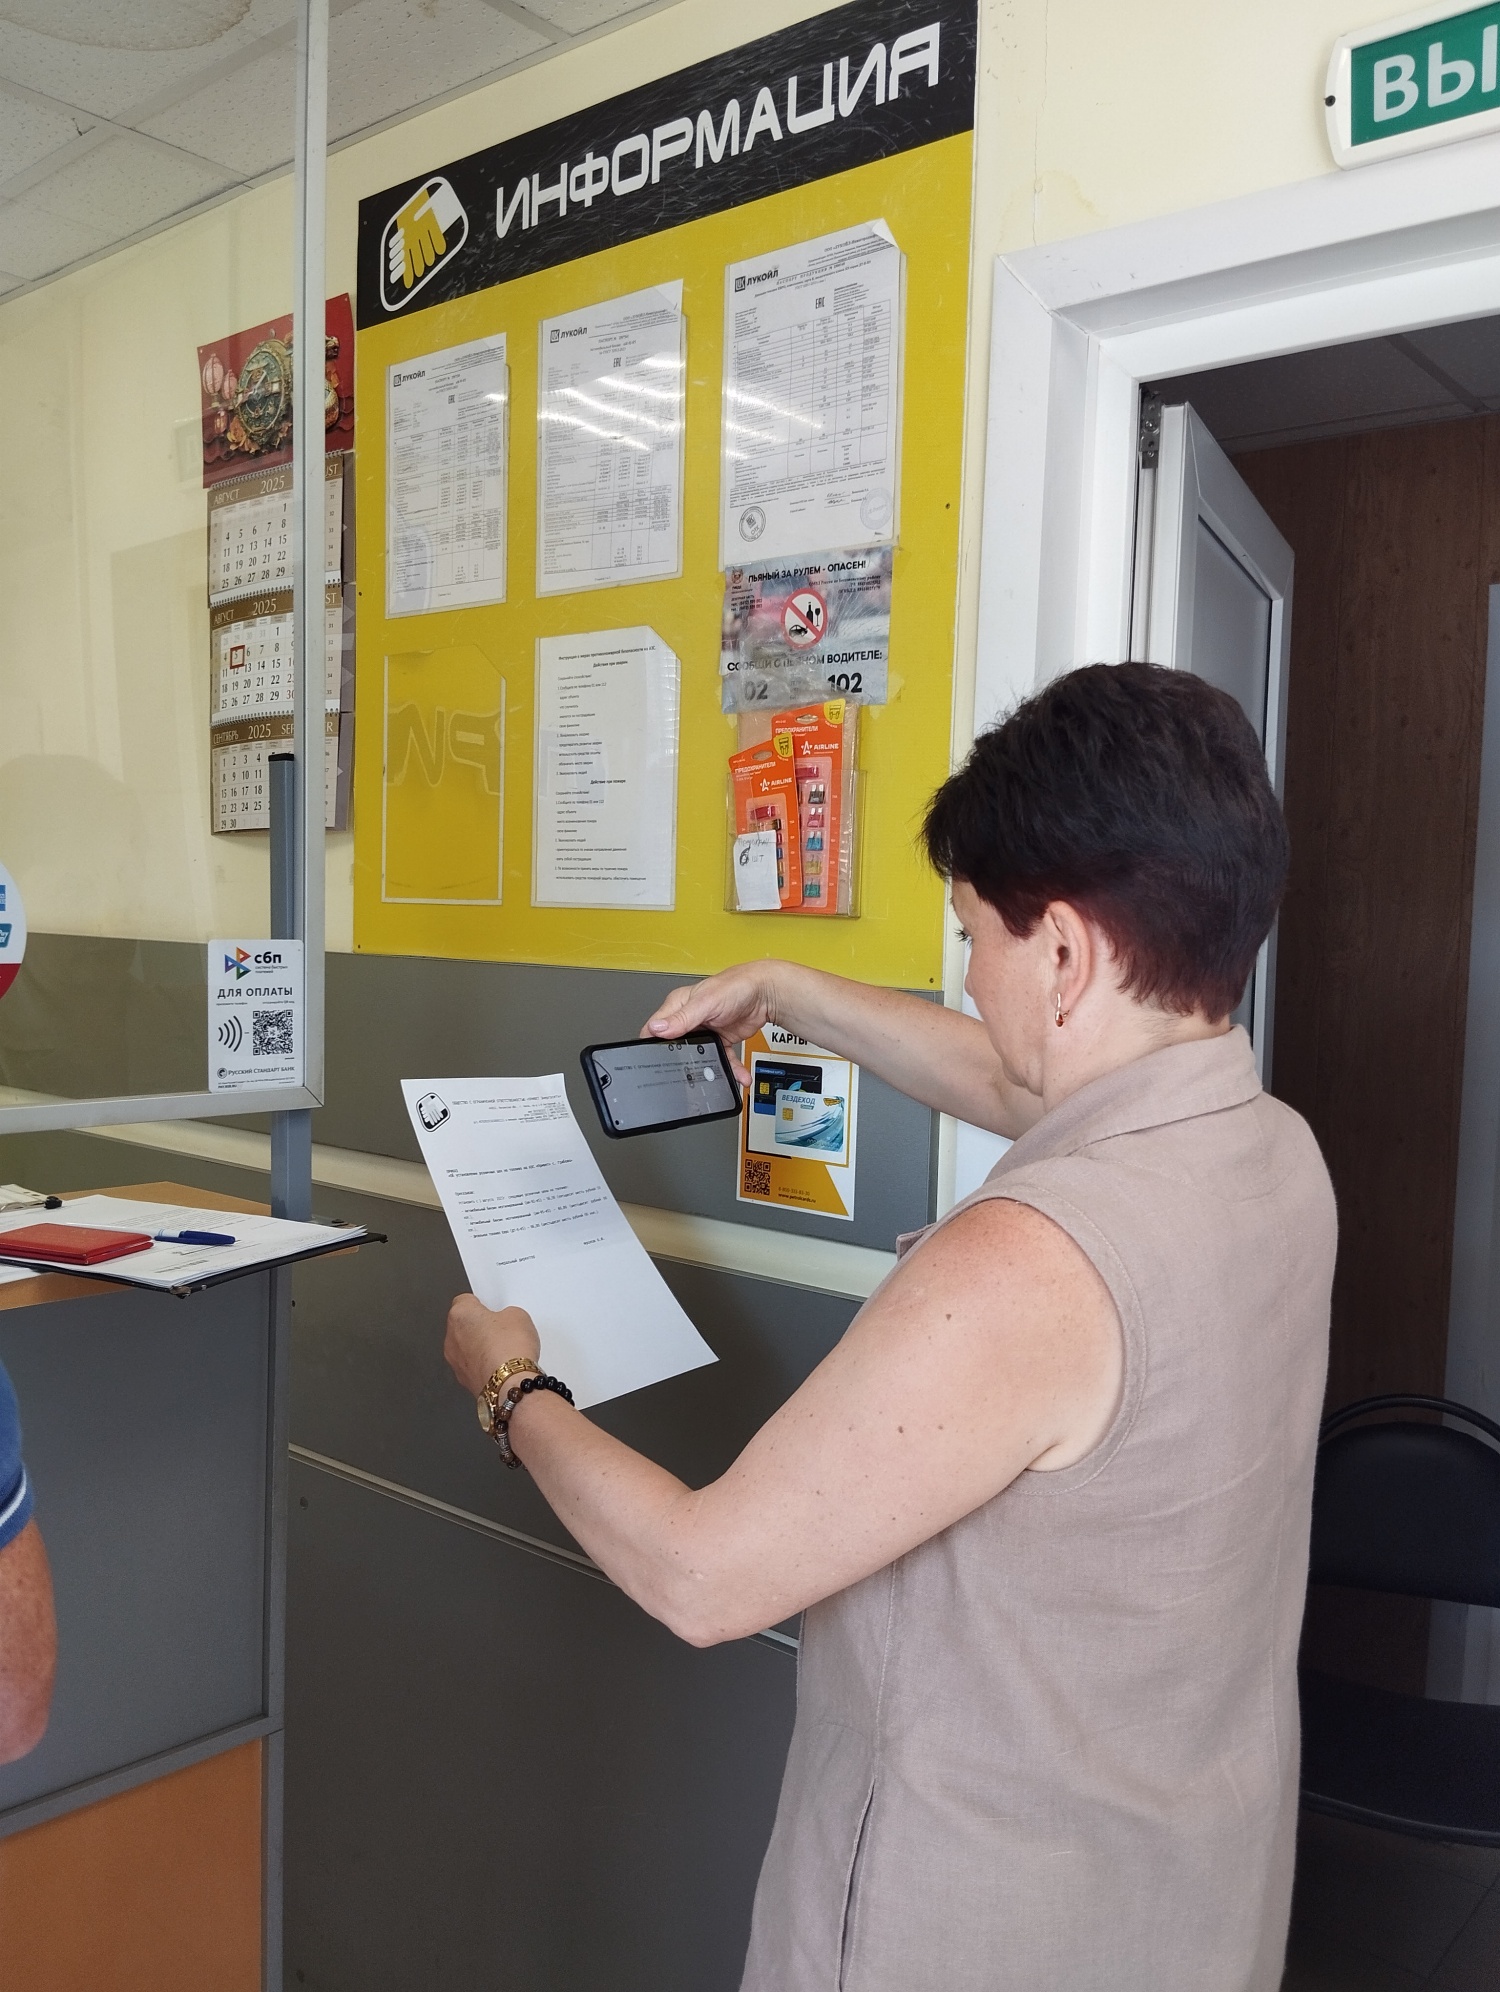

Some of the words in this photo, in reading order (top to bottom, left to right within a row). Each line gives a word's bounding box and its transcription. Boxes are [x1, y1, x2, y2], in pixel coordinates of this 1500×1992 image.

[1374, 24, 1498, 122] ВЫ
[496, 22, 941, 238] ИНФОРМАЦИЯ
[747, 270, 778, 286] ЛУКОЙЛ
[561, 327, 587, 338] ЛУКОЙЛ
[402, 370, 425, 382] ЛУКОЙЛ
[213, 488, 240, 505] АВГУСТ
[260, 475, 285, 494] 2025
[283, 503, 287, 512] 1
[226, 532, 230, 541] 4
[239, 529, 243, 538] 5
[252, 525, 257, 535] 6
[267, 522, 271, 532] 7
[281, 519, 286, 529] 8
[224, 548, 230, 557] 11
[236, 544, 244, 554] 12
[250, 541, 258, 551] 13
[264, 538, 272, 548] 14
[279, 534, 287, 544] 15
[223, 563, 230, 573] 18
[236, 560, 243, 570] 19
[249, 557, 256, 567] 20
[263, 554, 270, 564] 21
[277, 551, 286, 561] 22
[222, 579, 229, 589] 25
[234, 576, 242, 585] 26
[248, 573, 256, 583] 27
[261, 570, 269, 580] 28
[276, 567, 285, 577] 29
[748, 569, 780, 583] ПЬЯНЫЙ
[781, 568, 792, 578] ЗА
[794, 565, 821, 577] РУЛЕМ
[828, 560, 867, 573] ОПАСЕН!
[214, 609, 234, 623] АВГУСТ
[253, 599, 277, 616] 2025
[276, 627, 279, 636] 1
[224, 652, 227, 661] 4
[234, 650, 238, 659] 5
[247, 648, 250, 657] 6
[260, 645, 264, 654] 7
[275, 643, 279, 652] 8
[827, 650, 882, 665] ВОДИТЕЛЕ:
[222, 669, 228, 678] 11
[244, 663, 252, 672] 13
[258, 661, 265, 670] 14
[272, 659, 280, 669] 15
[222, 684, 228, 693] 18
[232, 681, 238, 691] 19
[244, 679, 251, 689] 20
[257, 676, 264, 686] 21
[271, 674, 280, 685] 22
[828, 672, 862, 694] 102
[222, 700, 227, 709] 25
[231, 697, 238, 707] 26
[243, 695, 250, 705] 27
[256, 693, 264, 703] 28
[270, 691, 279, 701] 29
[213, 730, 239, 745] СЕНТЯБРЬ
[248, 723, 271, 740] 2025
[223, 758, 226, 767] 1
[233, 756, 236, 766] 2
[244, 755, 248, 764] 3
[257, 753, 260, 762] 4
[223, 774, 226, 783] 8
[232, 772, 236, 781] 9
[242, 770, 249, 780] 10
[255, 769, 262, 779] 11
[771, 778, 792, 786] AIRLINE
[221, 789, 227, 798] 15
[231, 787, 237, 797] 16
[242, 786, 249, 795] 17
[255, 785, 262, 795] 18
[221, 804, 226, 813] 22
[231, 803, 237, 813] 23
[241, 802, 248, 812] 24
[254, 801, 262, 811] 25
[221, 820, 226, 829] 29
[230, 819, 236, 828] 30
[254, 952, 282, 964] сбп
[217, 988, 241, 999] ДЛЯ
[246, 987, 293, 997] ОПЛАТЫ
[782, 1095, 815, 1105] ВЕЗДЕХОД
